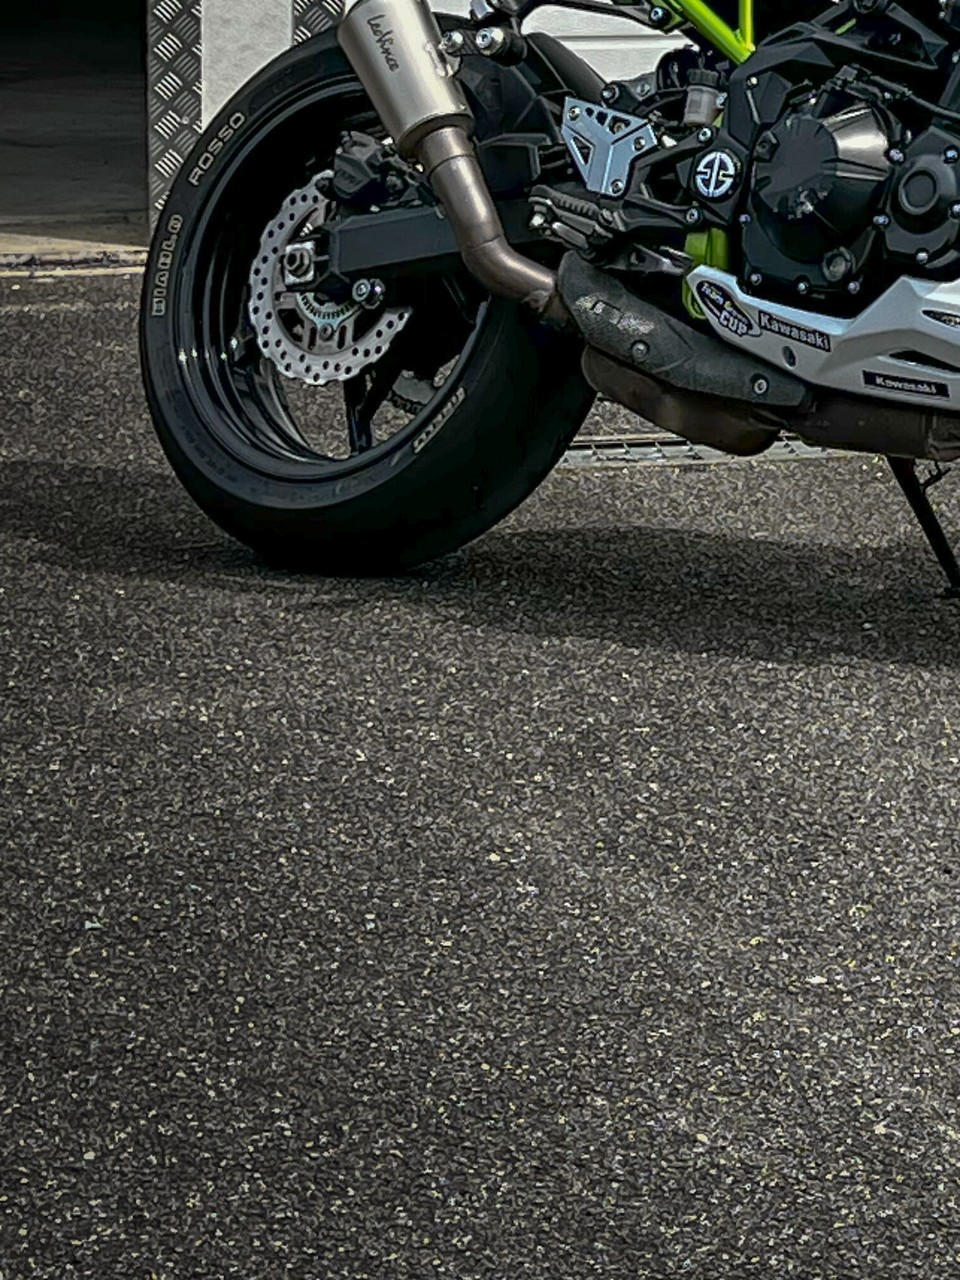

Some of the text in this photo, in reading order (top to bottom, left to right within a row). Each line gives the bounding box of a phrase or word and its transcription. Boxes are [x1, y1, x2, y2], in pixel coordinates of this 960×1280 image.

[188, 112, 246, 186] ROSSO
[718, 309, 748, 336] CUP
[760, 312, 829, 350] Kawasaki
[875, 376, 938, 395] Kawasaki
